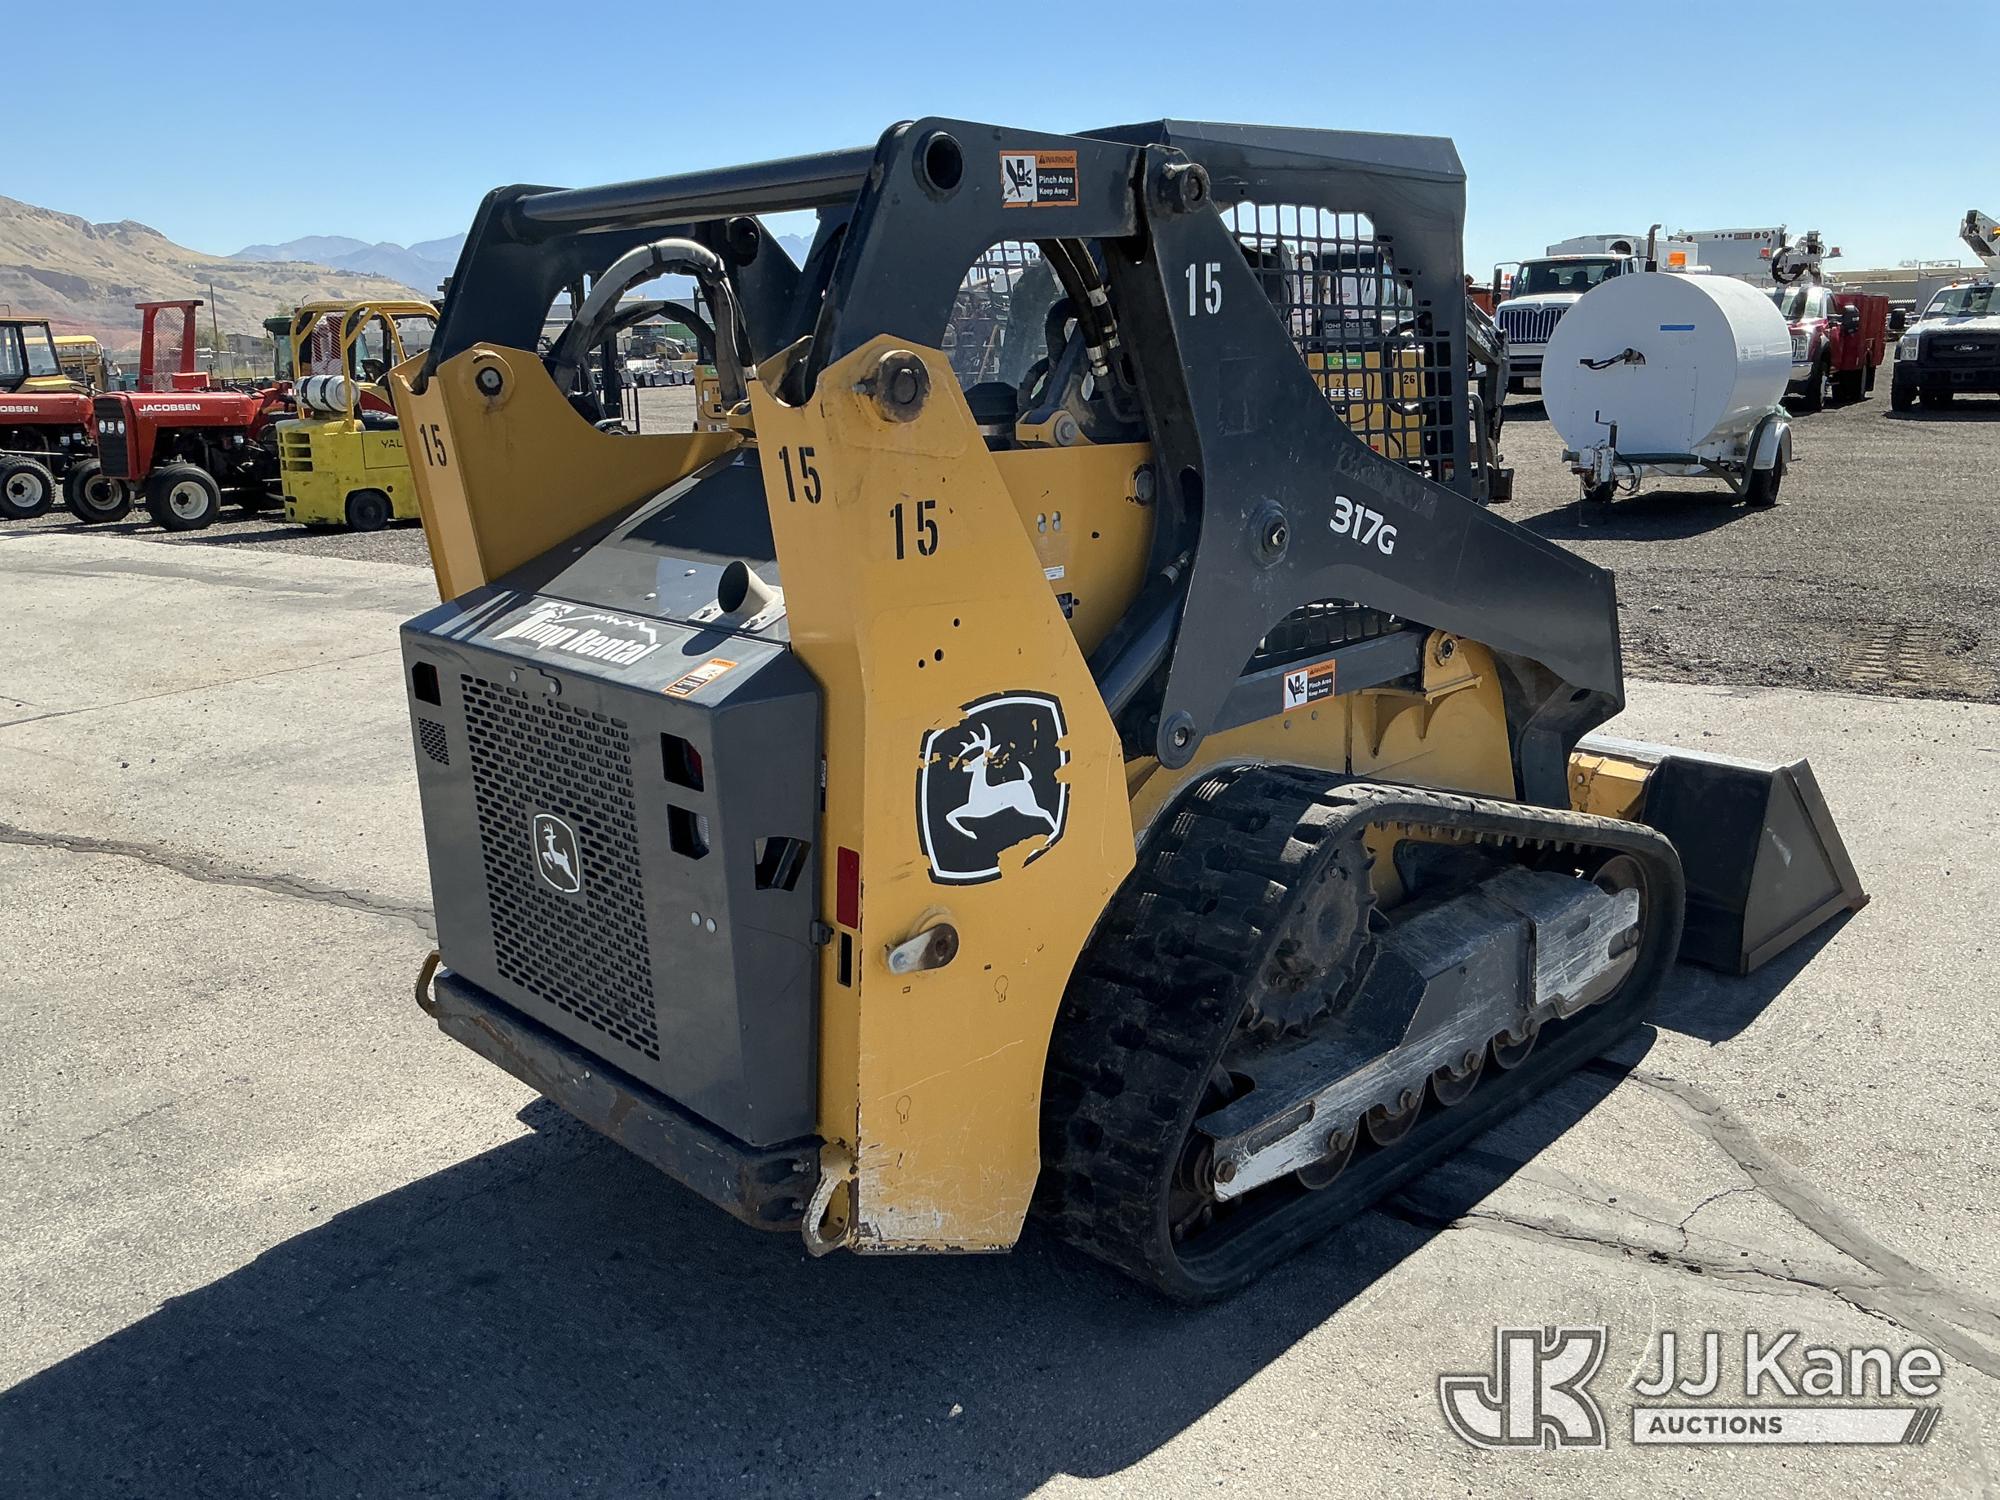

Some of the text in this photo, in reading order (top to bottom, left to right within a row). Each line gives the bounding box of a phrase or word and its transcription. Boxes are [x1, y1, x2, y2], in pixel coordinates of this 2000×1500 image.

[1039, 175, 1073, 184] Pinch Area
[1039, 187, 1069, 196] Keep Away
[1185, 262, 1222, 316] 15
[1403, 375, 1415, 384] 26
[0, 405, 39, 413] OBSEN
[139, 403, 201, 412] JACOBSEN
[420, 423, 447, 467] 15
[778, 445, 822, 505] 15
[889, 500, 939, 561] 15
[1329, 495, 1398, 555] 317G
[492, 601, 663, 666] Timp Rental
